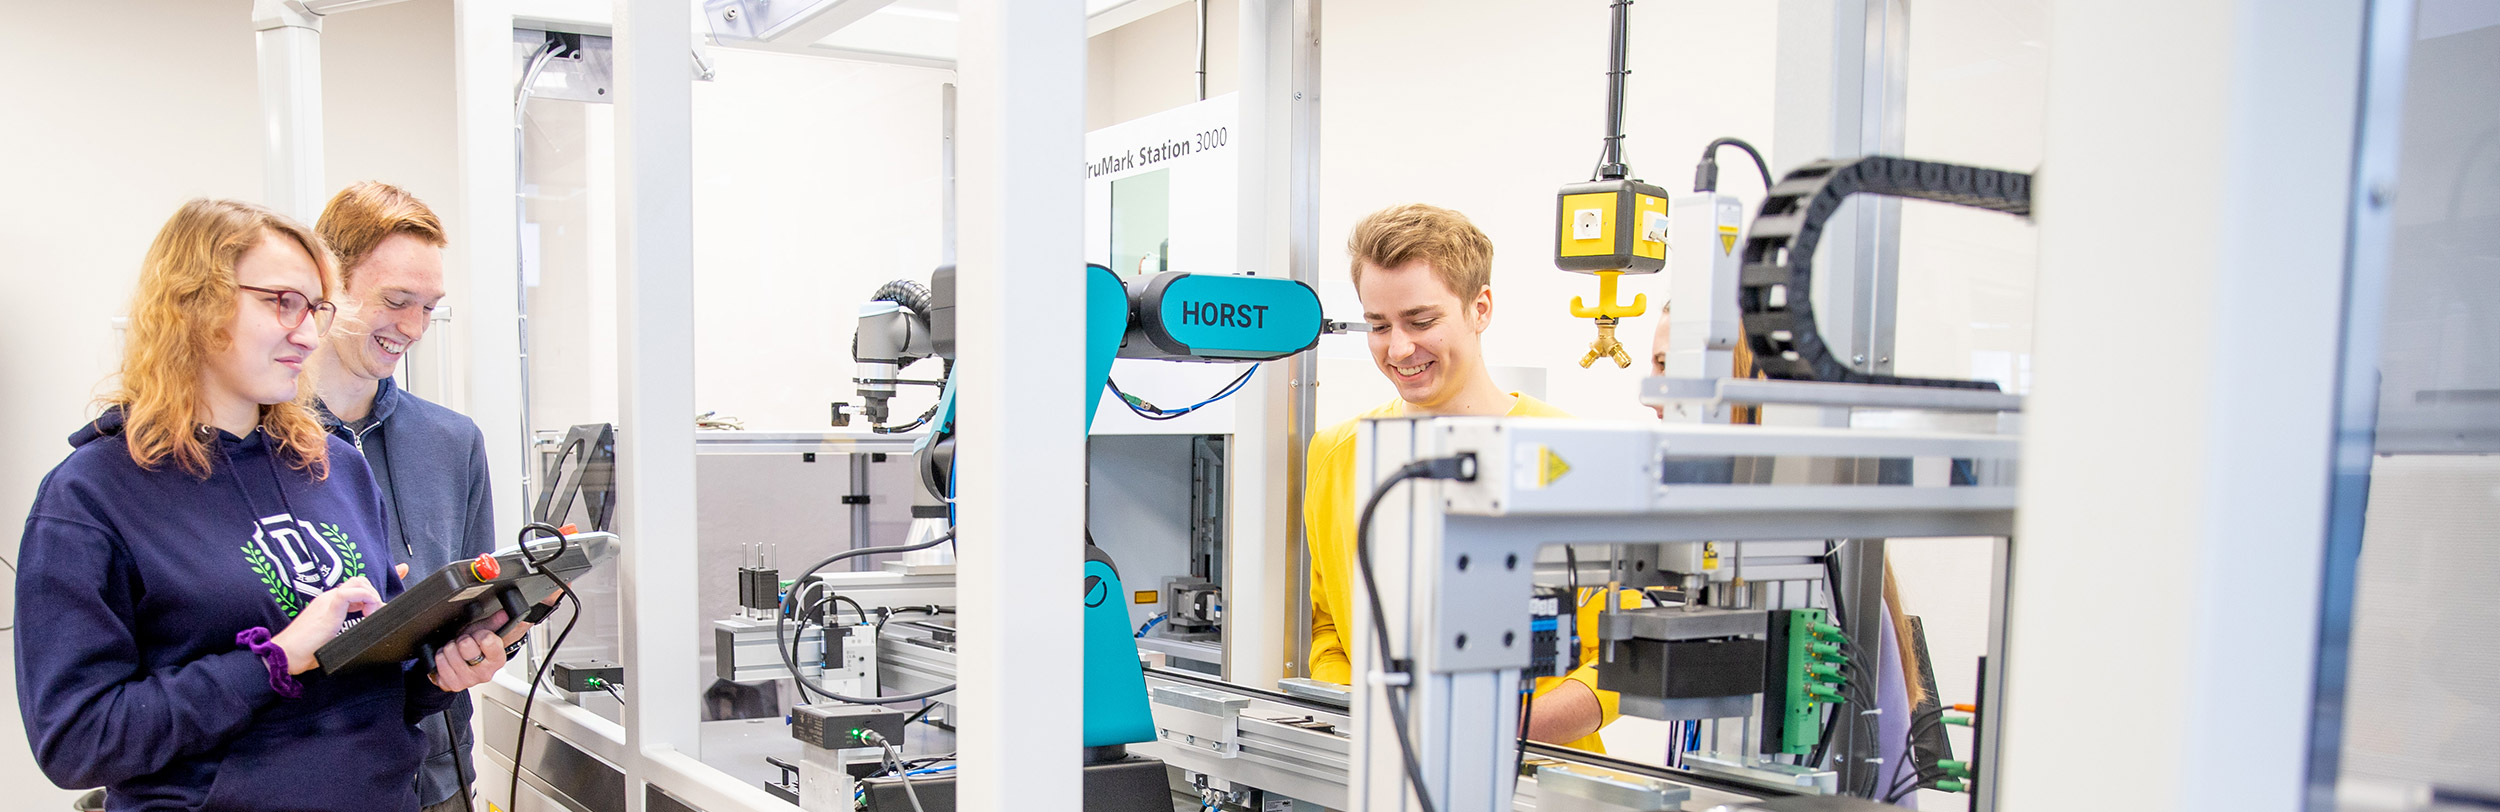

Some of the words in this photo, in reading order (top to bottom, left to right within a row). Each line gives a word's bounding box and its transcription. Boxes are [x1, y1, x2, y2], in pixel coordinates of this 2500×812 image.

[1139, 139, 1190, 166] Station
[1195, 126, 1228, 153] 3000
[1182, 301, 1269, 329] HORST
